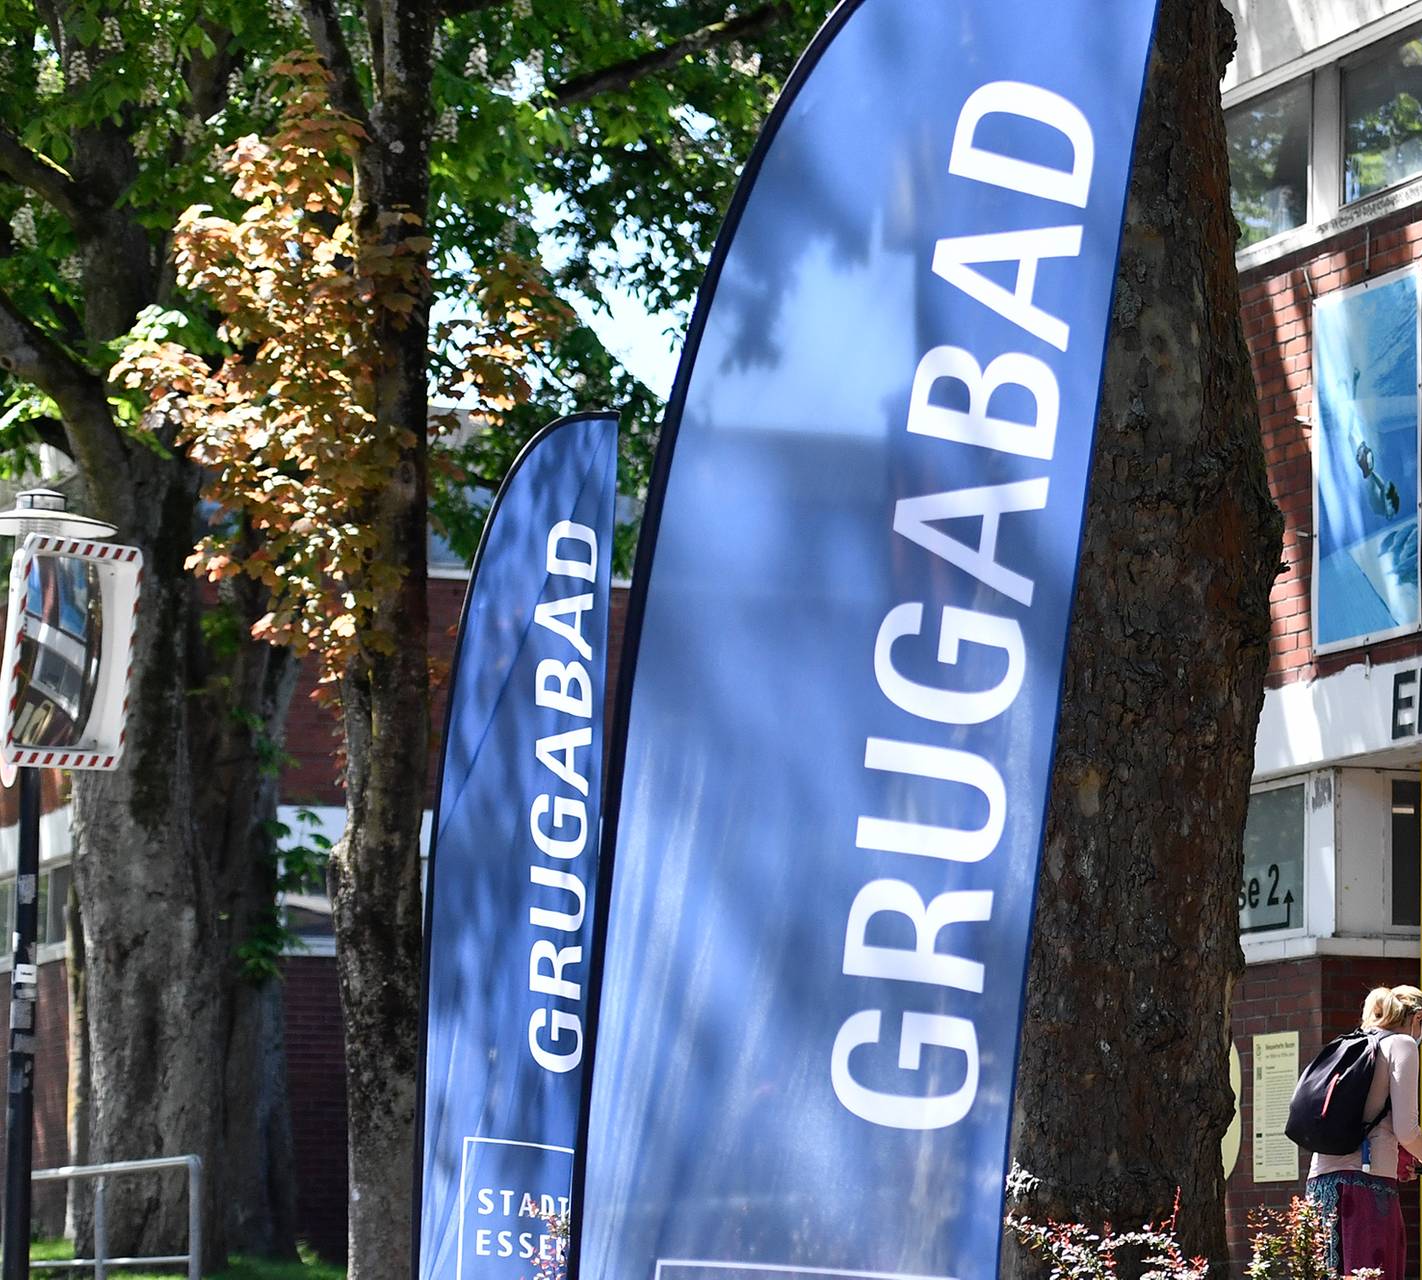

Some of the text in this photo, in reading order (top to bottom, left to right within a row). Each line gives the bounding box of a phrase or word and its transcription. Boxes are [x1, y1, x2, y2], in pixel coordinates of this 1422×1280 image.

[830, 80, 1095, 1130] GRUGABAD
[528, 519, 598, 1074] GRUGABAD
[1267, 864, 1279, 906] 2
[477, 1188, 569, 1222] STADT
